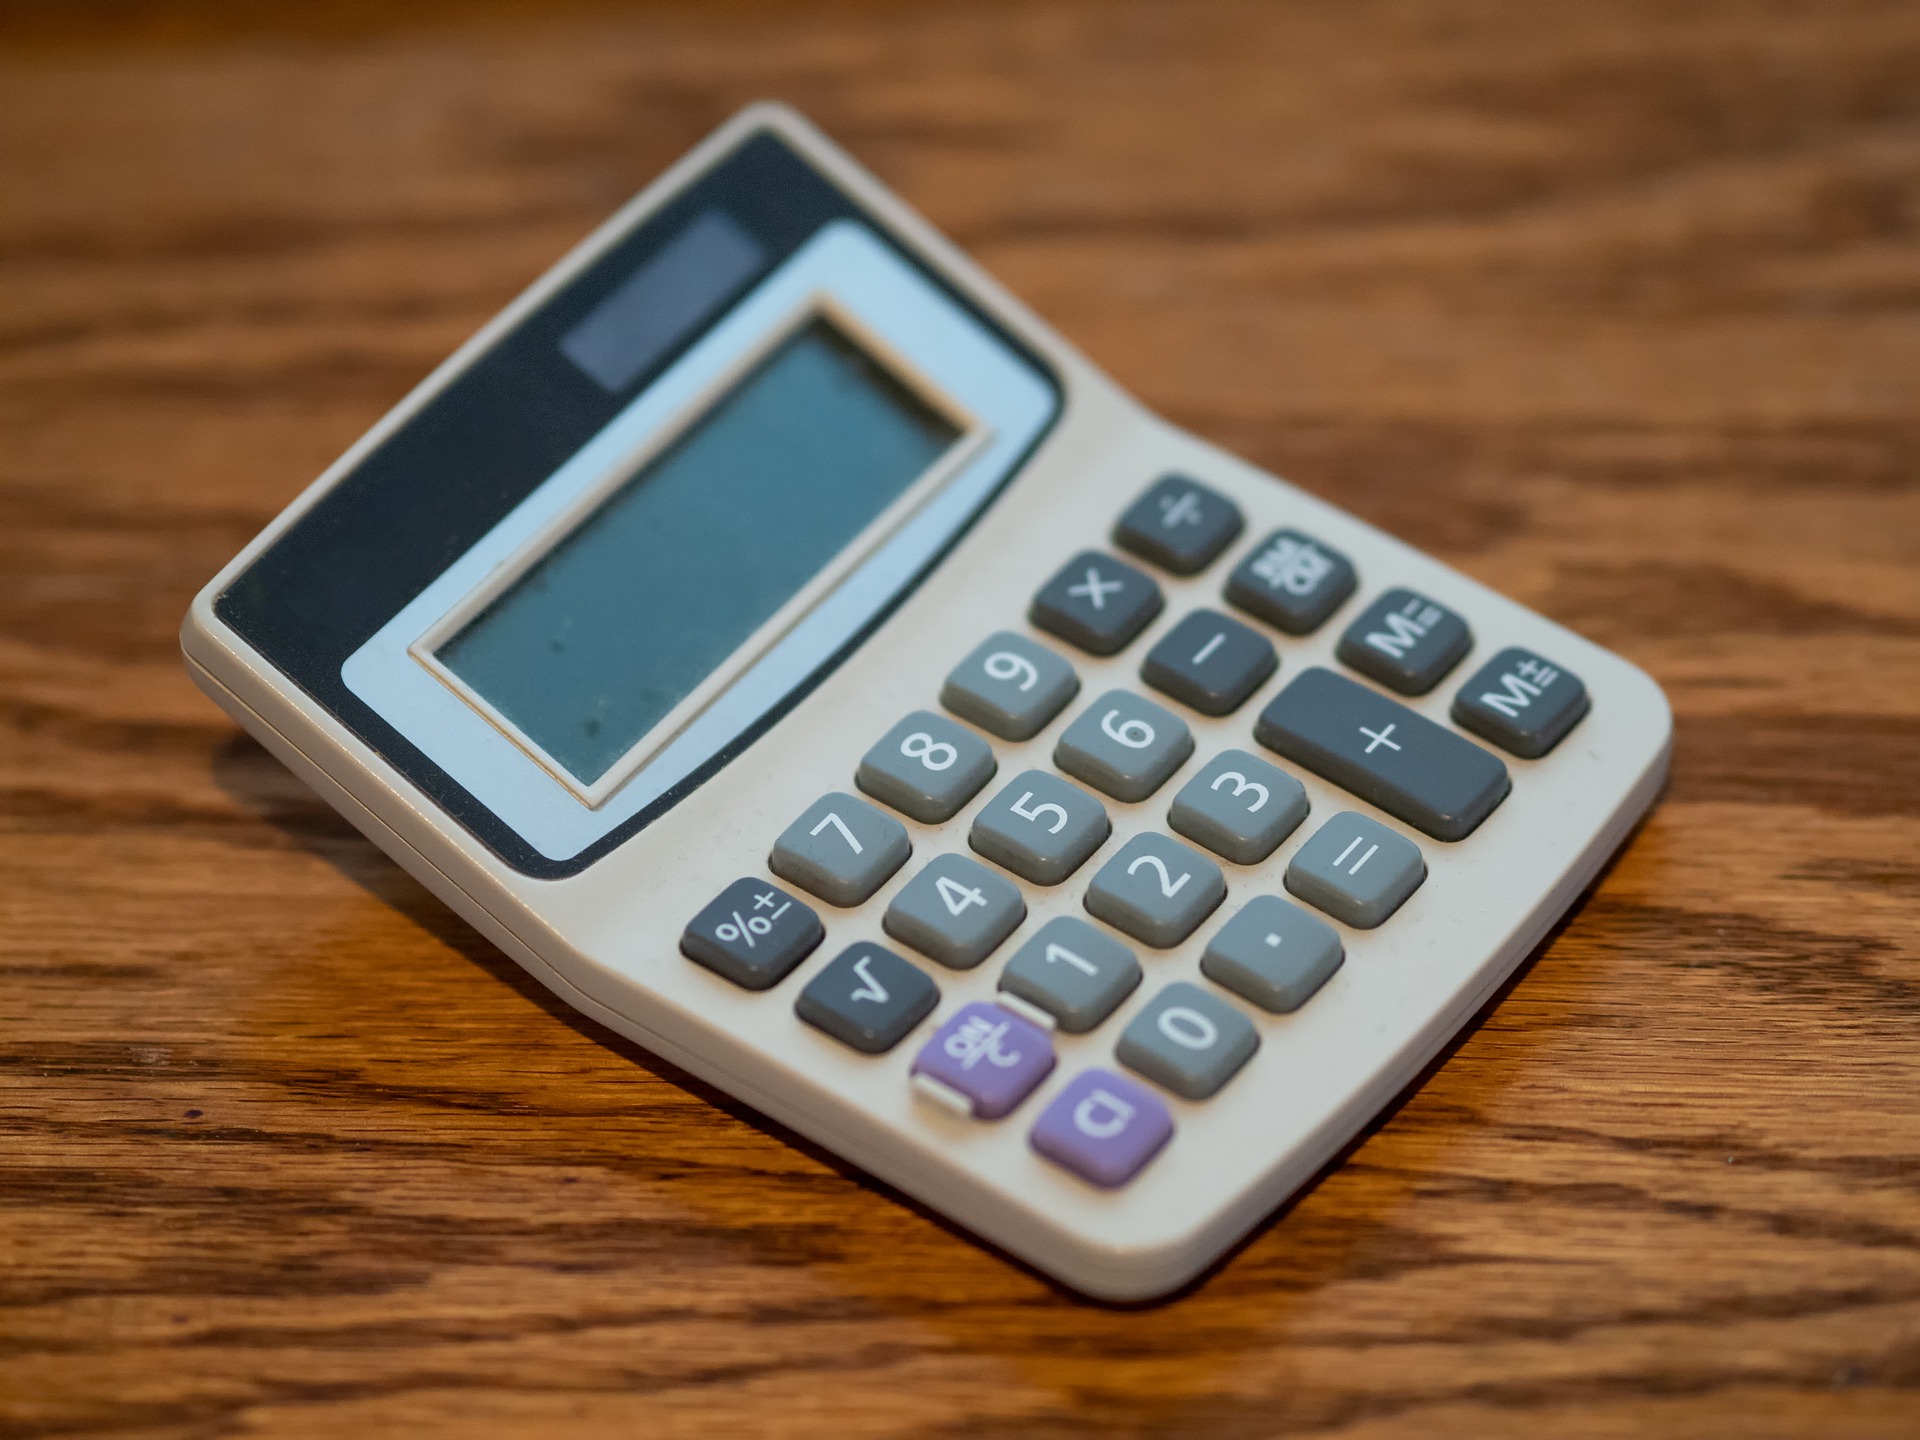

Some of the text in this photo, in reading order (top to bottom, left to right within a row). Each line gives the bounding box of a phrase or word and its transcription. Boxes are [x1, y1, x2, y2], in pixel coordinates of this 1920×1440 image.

[985, 651, 1038, 691] 9
[1102, 710, 1155, 749] 6
[901, 733, 958, 771] 8
[1211, 772, 1270, 813] 3
[810, 812, 863, 855] 7
[1010, 792, 1068, 835] 5
[935, 876, 988, 916] 4
[1127, 855, 1191, 898] 2
[1045, 943, 1098, 976] 1
[1157, 1006, 1217, 1049] 0
